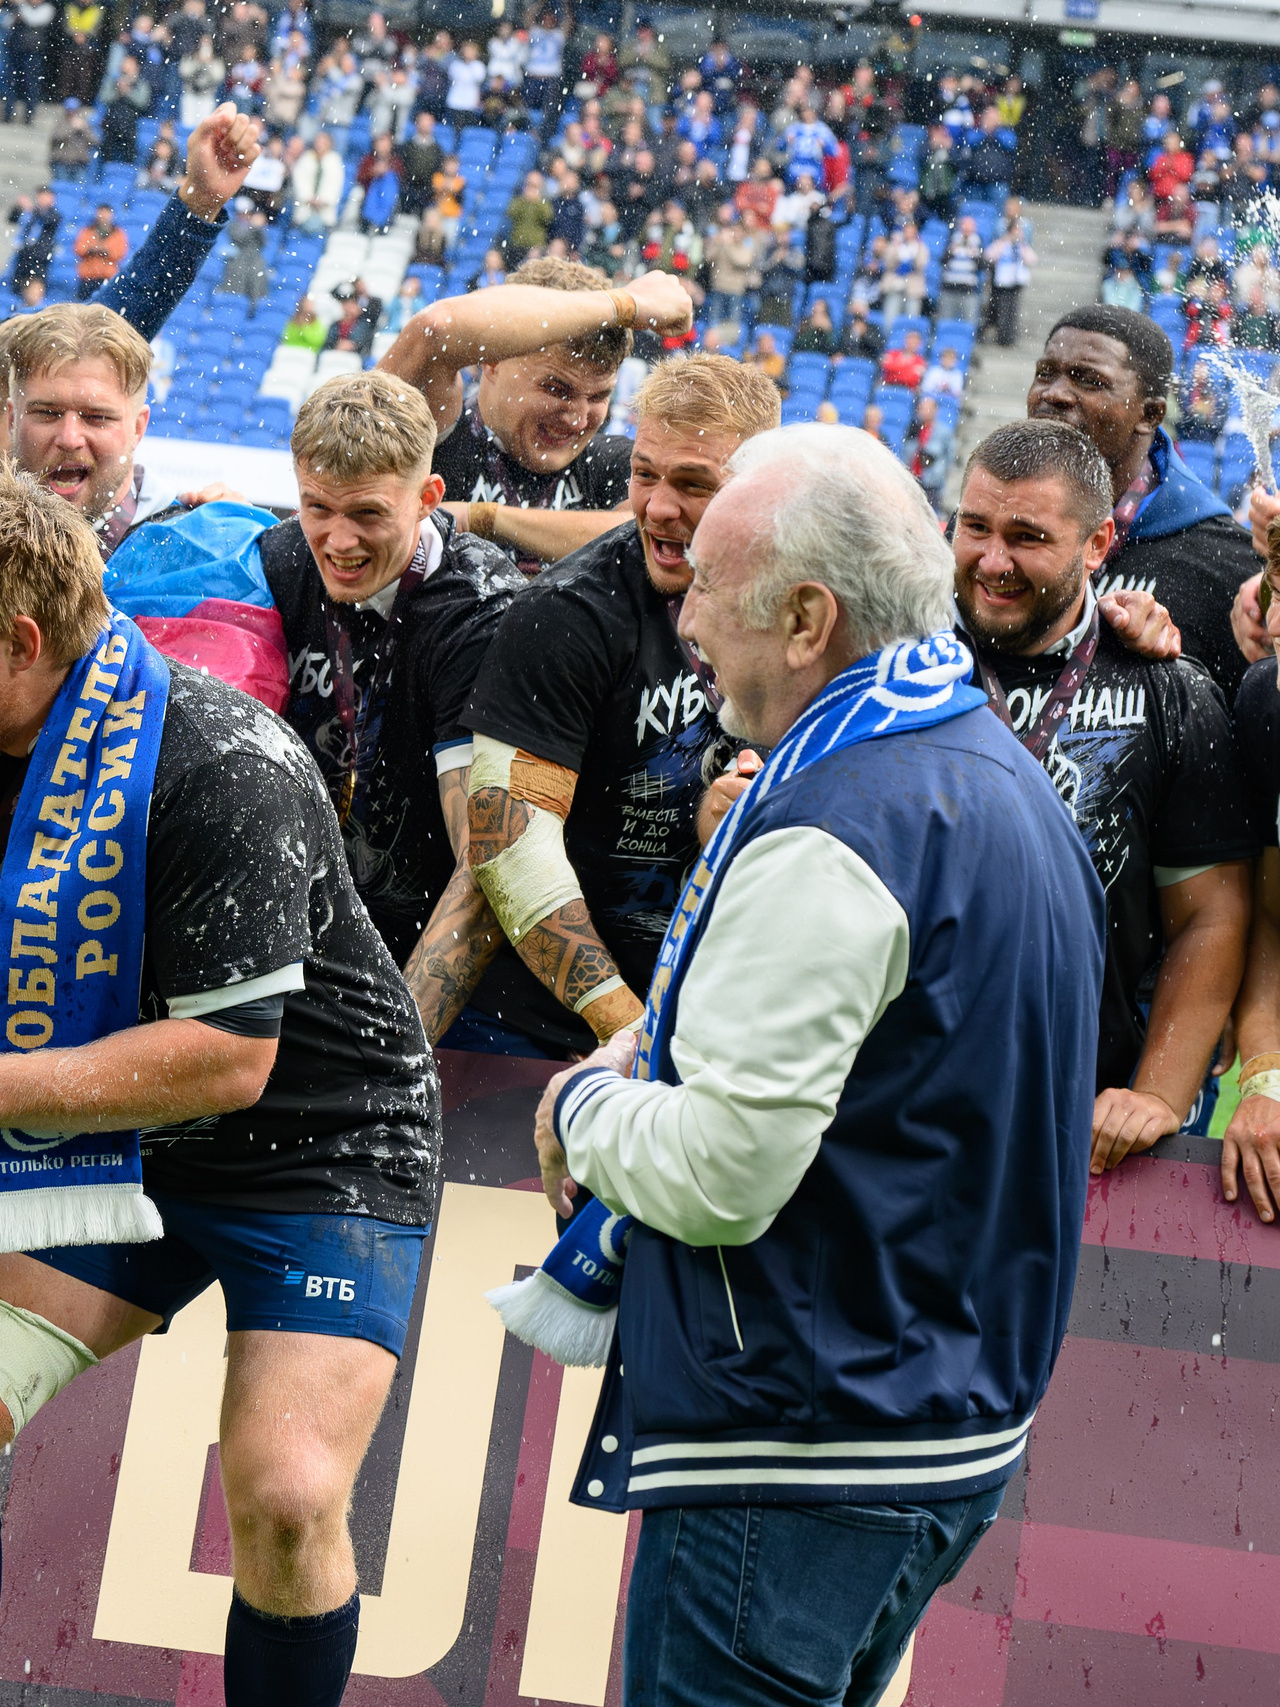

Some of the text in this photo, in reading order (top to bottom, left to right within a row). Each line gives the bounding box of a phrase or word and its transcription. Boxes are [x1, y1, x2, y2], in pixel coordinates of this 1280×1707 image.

[1067, 684, 1147, 734] НАШ
[621, 805, 680, 823] ВМЕСТЕ
[76, 690, 147, 981] РОССИИ
[622, 818, 670, 838] И ДО
[6, 634, 127, 1050] ОБЛАДАТЕЛЬ
[616, 836, 668, 854] КОНЦА
[70, 1153, 124, 1169] РЕГБИ
[305, 1275, 356, 1302] ВТБ
